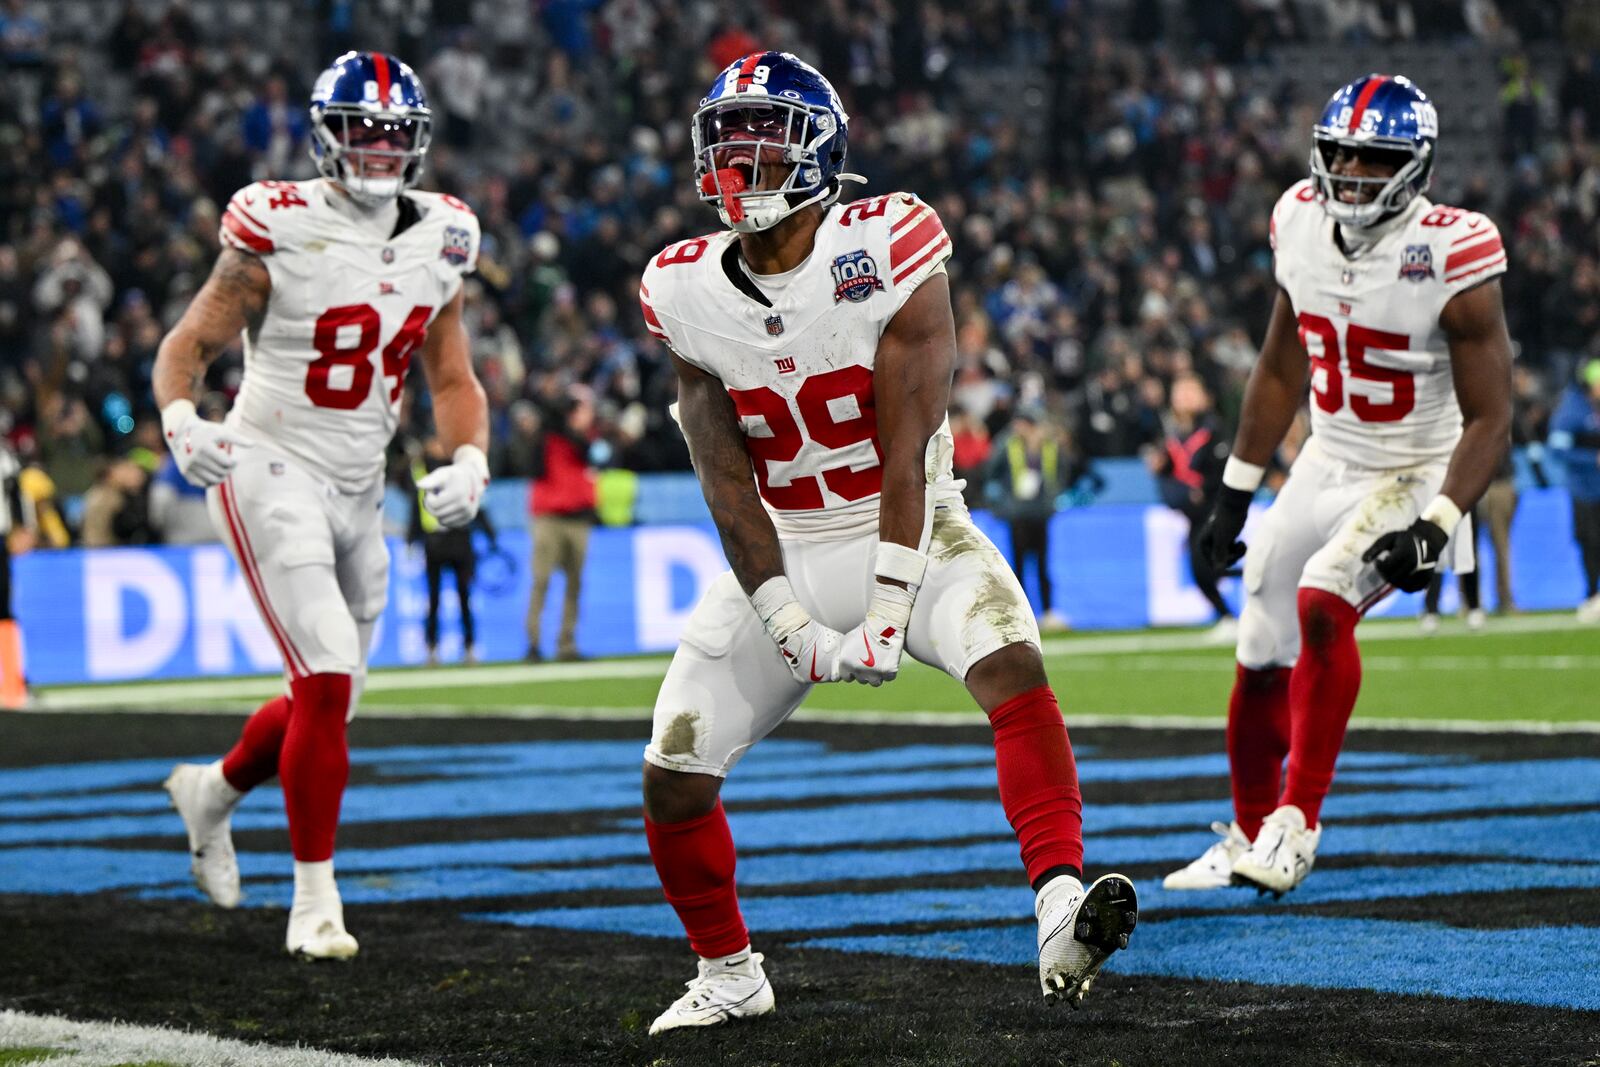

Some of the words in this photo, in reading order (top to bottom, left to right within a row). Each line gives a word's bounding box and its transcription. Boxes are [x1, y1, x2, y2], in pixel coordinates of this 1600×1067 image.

[831, 256, 877, 287] 100
[305, 303, 434, 410] 84
[1297, 312, 1416, 422] 85
[728, 364, 886, 511] 29
